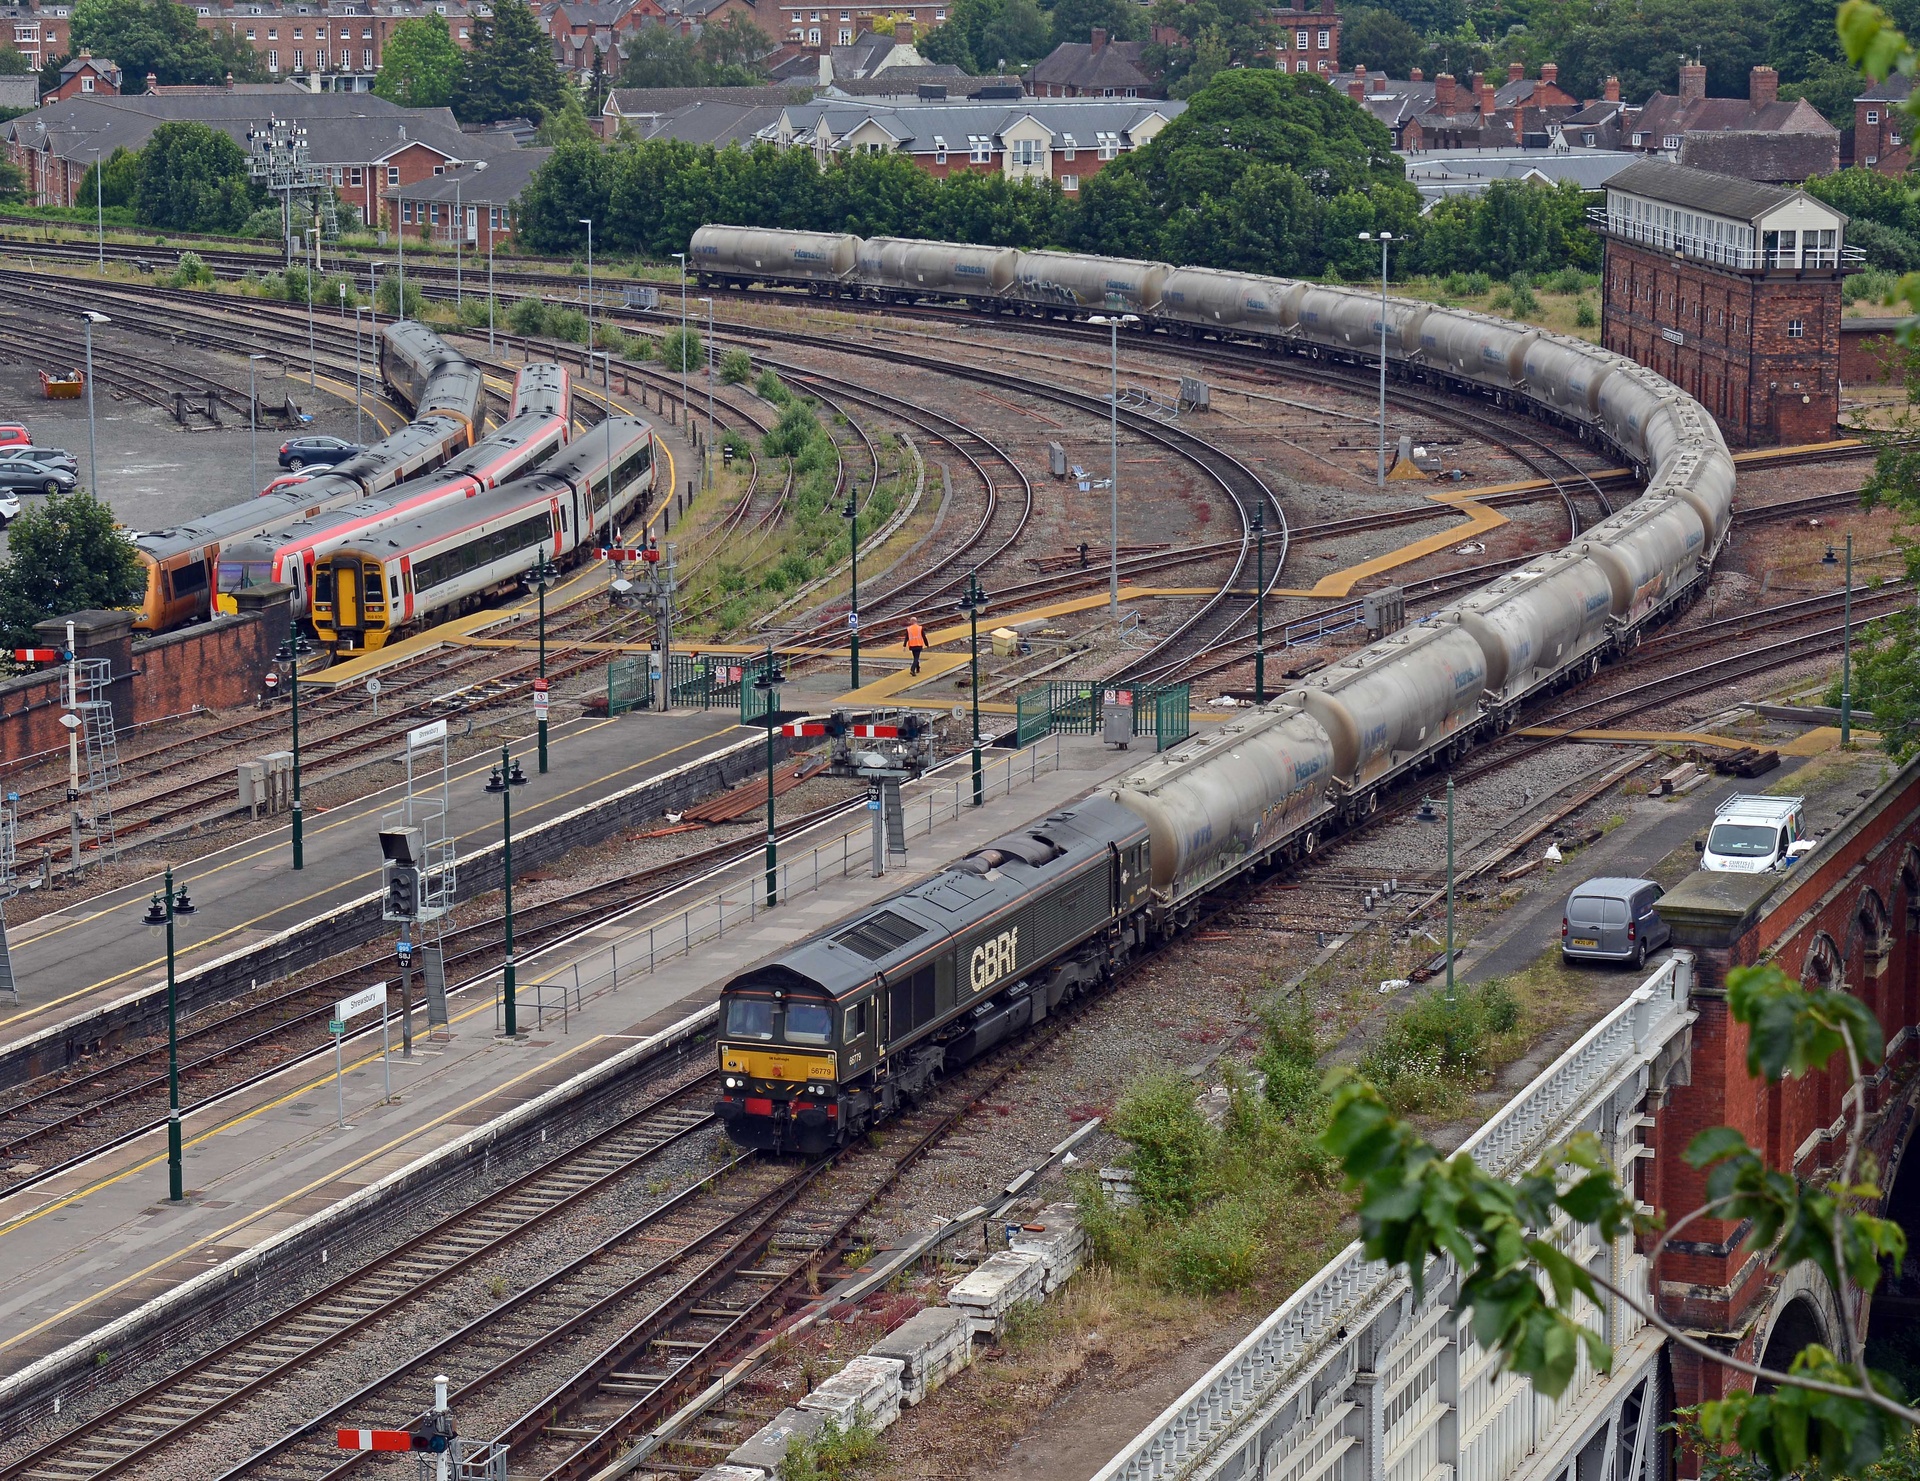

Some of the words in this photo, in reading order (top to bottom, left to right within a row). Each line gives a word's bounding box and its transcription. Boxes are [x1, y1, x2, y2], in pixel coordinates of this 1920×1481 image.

[702, 246, 718, 255] VTG
[955, 262, 986, 275] Hanson
[956, 708, 963, 716] 15
[418, 727, 439, 739] Shrewsbury
[1293, 751, 1329, 783] Hanson
[970, 926, 1019, 993] GBRf
[350, 993, 376, 1009] Shrewsbury
